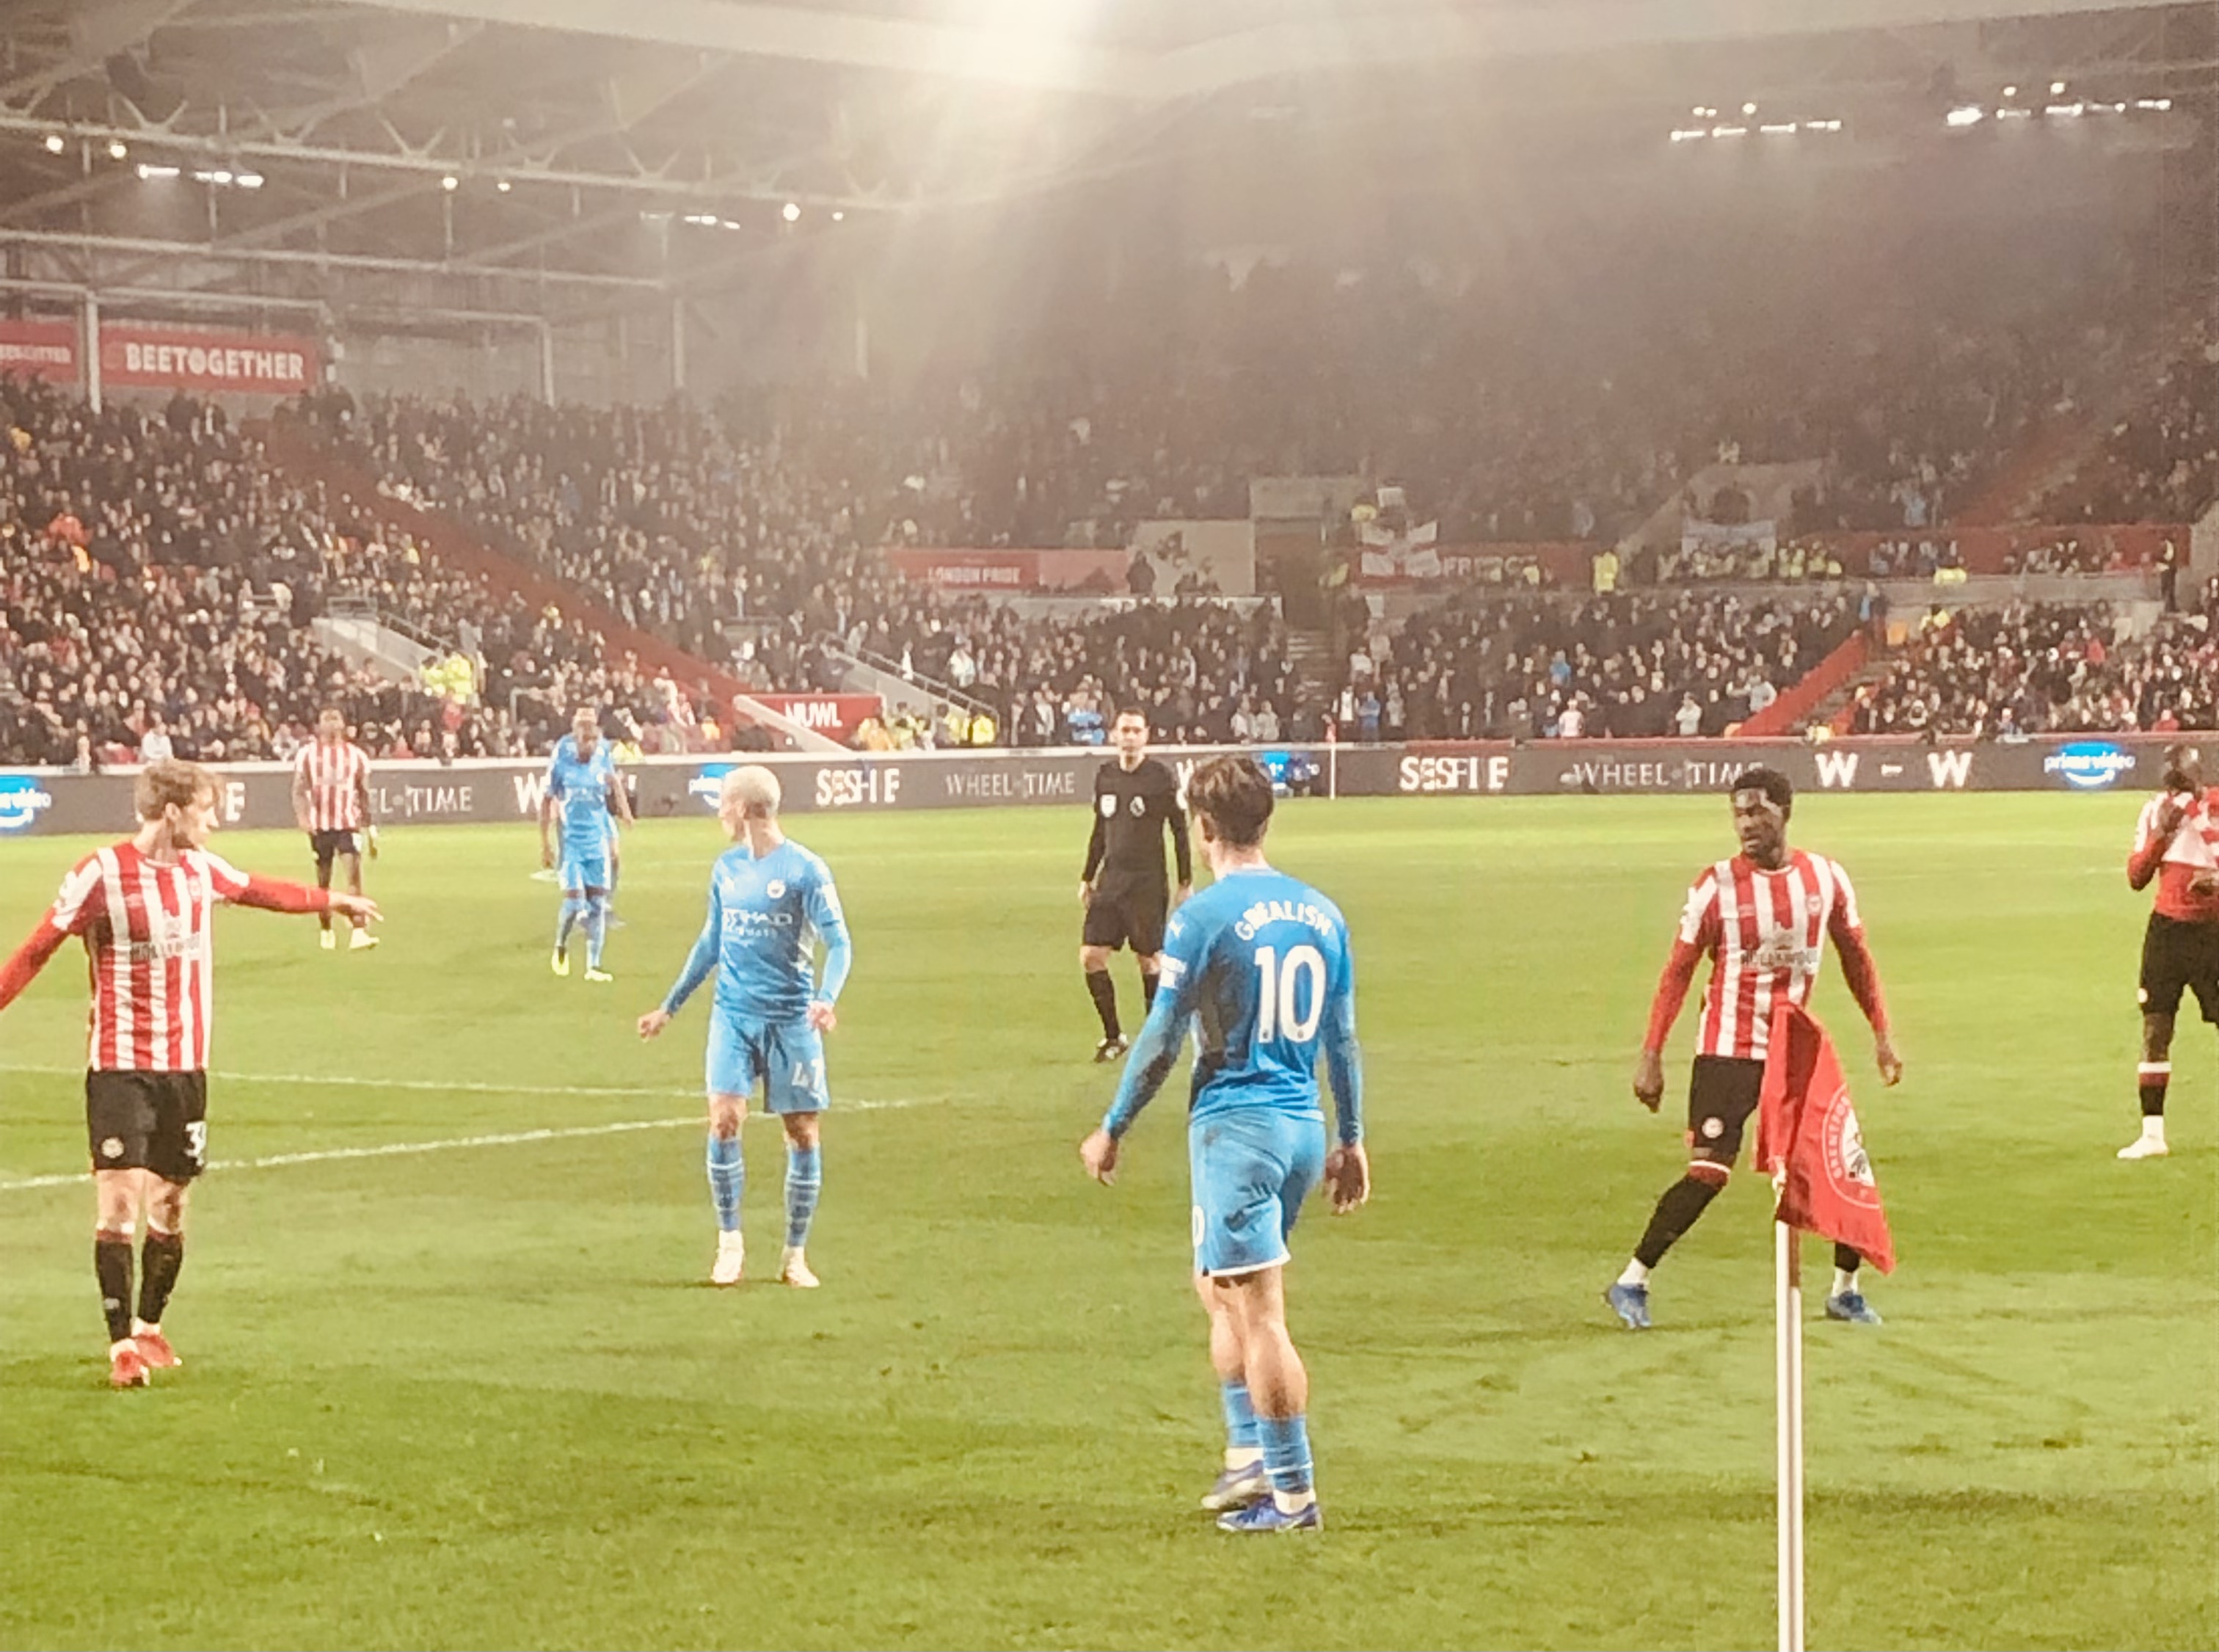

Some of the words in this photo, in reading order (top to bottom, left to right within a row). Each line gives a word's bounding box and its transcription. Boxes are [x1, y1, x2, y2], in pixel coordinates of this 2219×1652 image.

[126, 342, 304, 380] BEETOGETHER
[944, 773, 1013, 797] WHEEL
[1024, 771, 1075, 798] TIME
[1573, 761, 1669, 787] WHEEL
[407, 785, 472, 817] TIME
[1254, 944, 1327, 1044] 10
